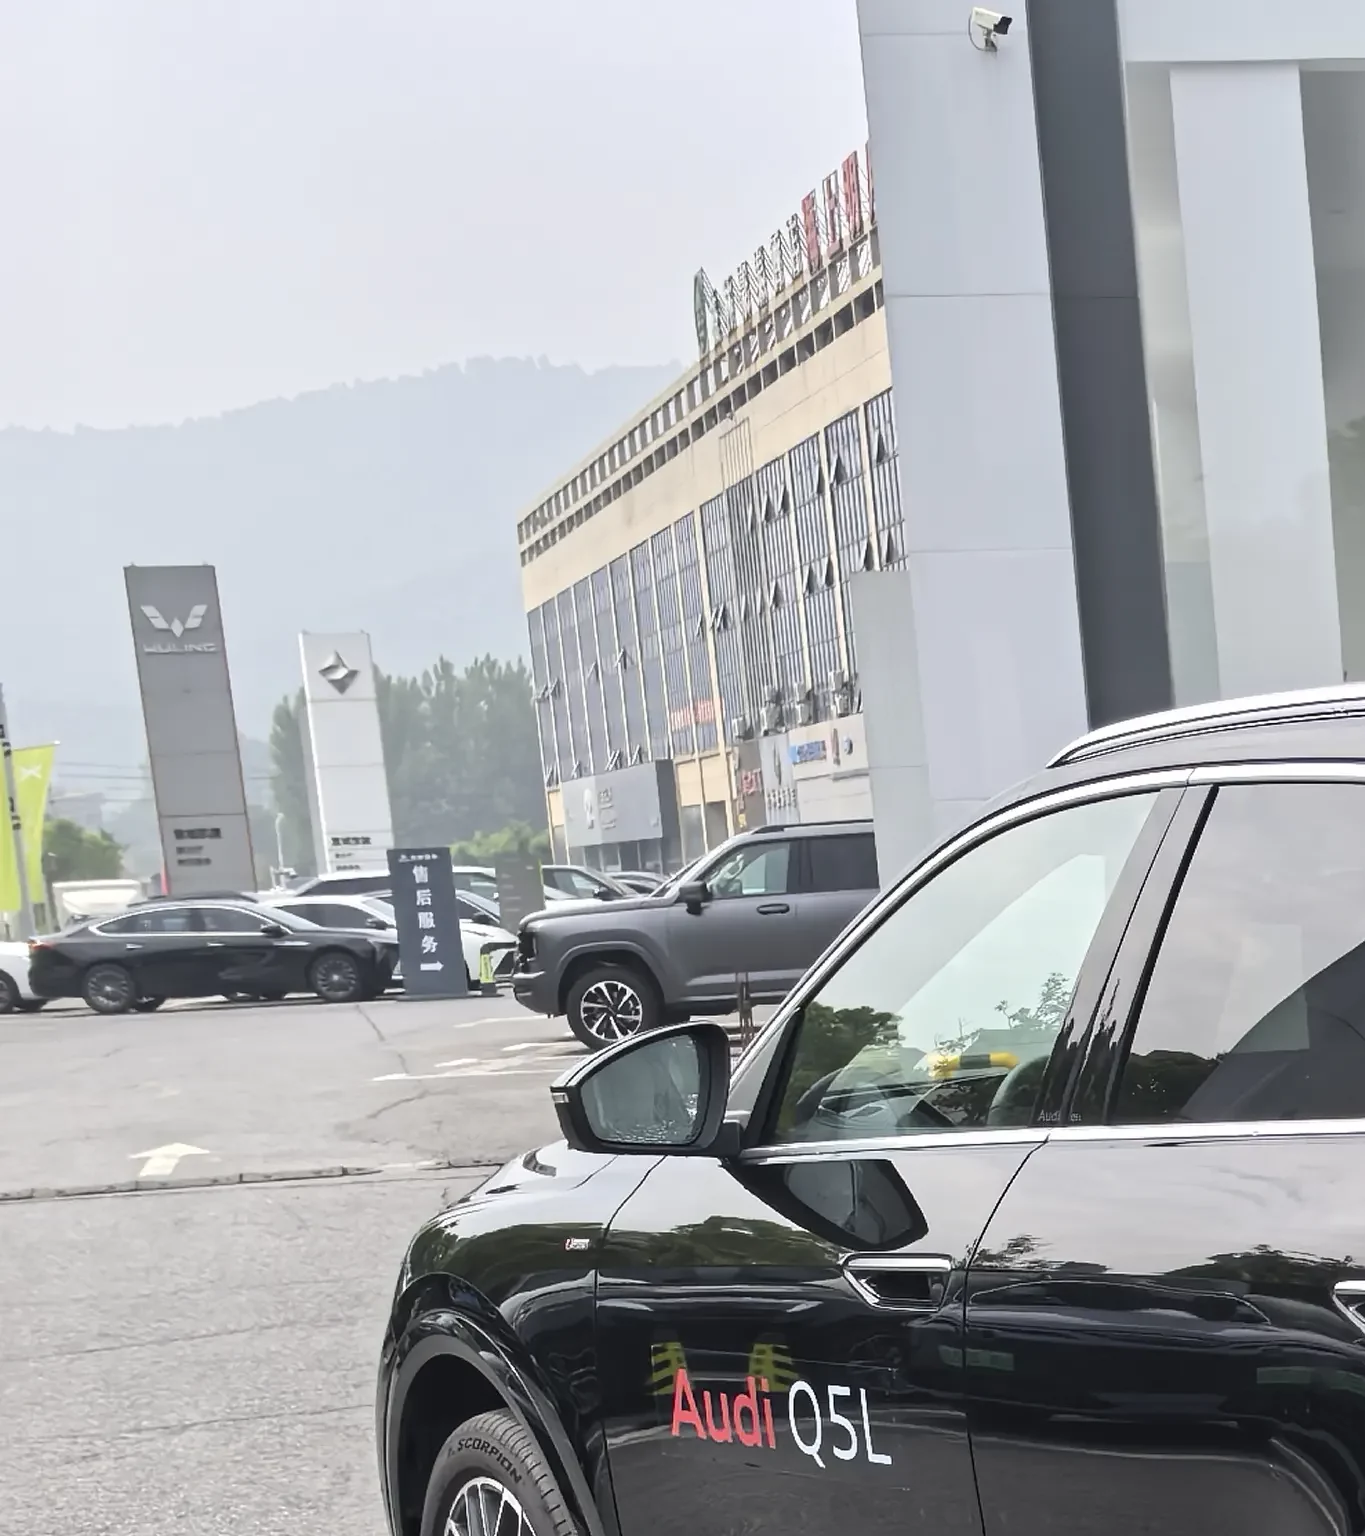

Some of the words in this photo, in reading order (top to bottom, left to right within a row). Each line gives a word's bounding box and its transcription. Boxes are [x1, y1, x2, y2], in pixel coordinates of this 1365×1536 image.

[412, 864, 439, 954] 售后服务
[457, 1436, 523, 1485] SCORPION
[671, 1368, 777, 1450] Audi
[788, 1380, 892, 1469] Q5L
